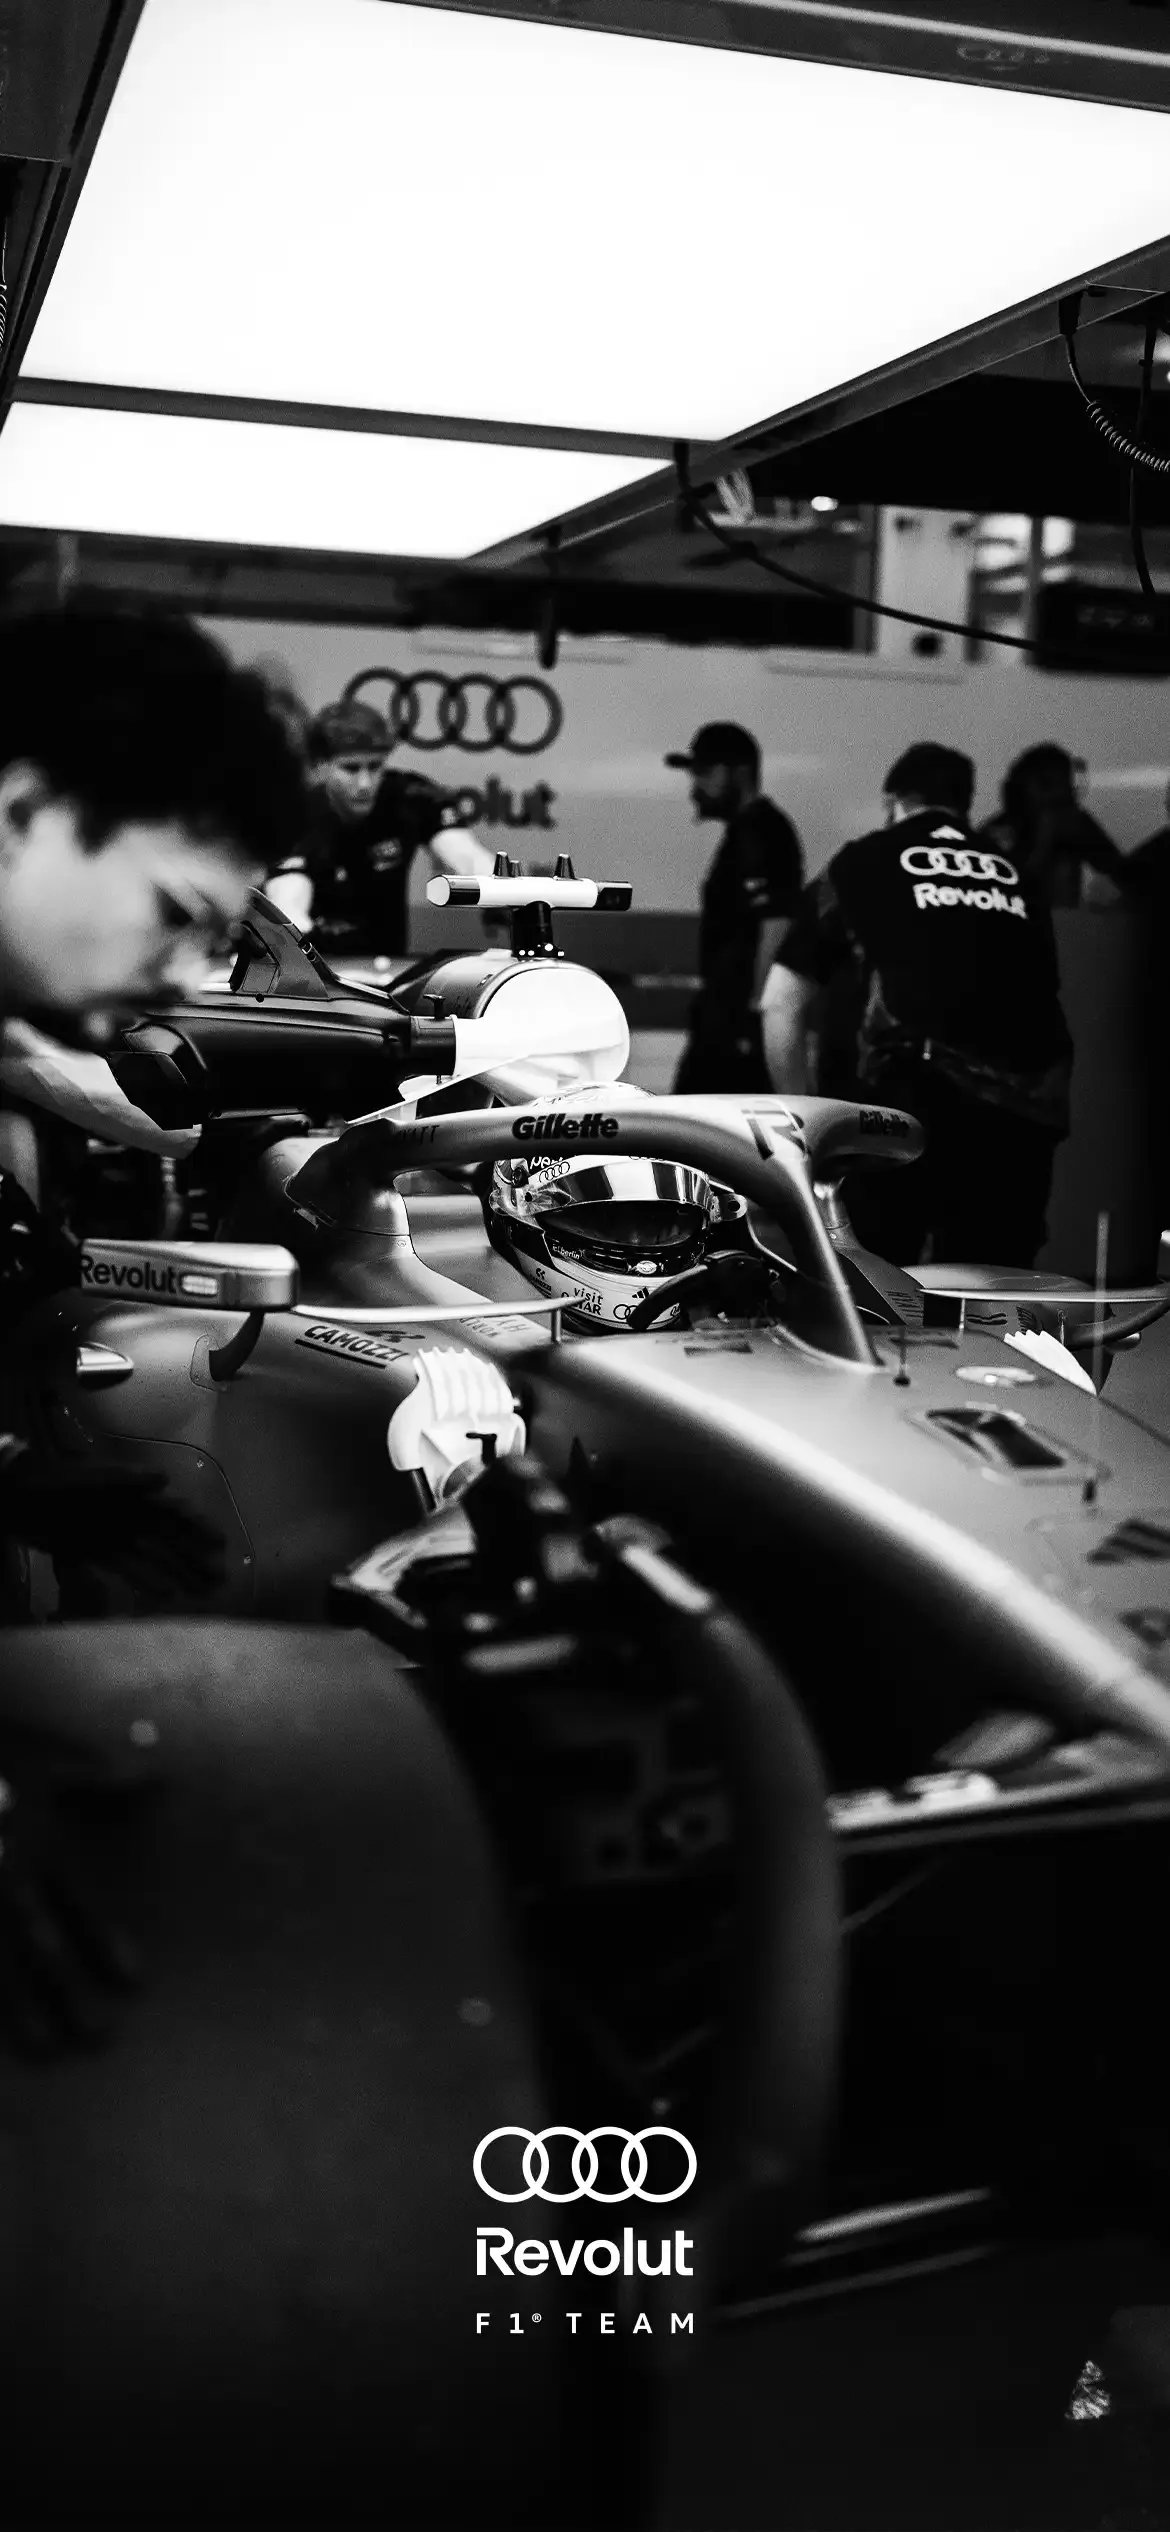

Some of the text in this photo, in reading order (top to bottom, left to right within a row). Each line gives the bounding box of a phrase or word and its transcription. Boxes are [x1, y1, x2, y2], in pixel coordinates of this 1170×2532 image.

[455, 773, 558, 829] olut
[512, 1113, 619, 1140] Gillette
[80, 1255, 177, 1293] Revolut
[574, 1287, 603, 1305] visit
[304, 1325, 410, 1361] CAMOZZI
